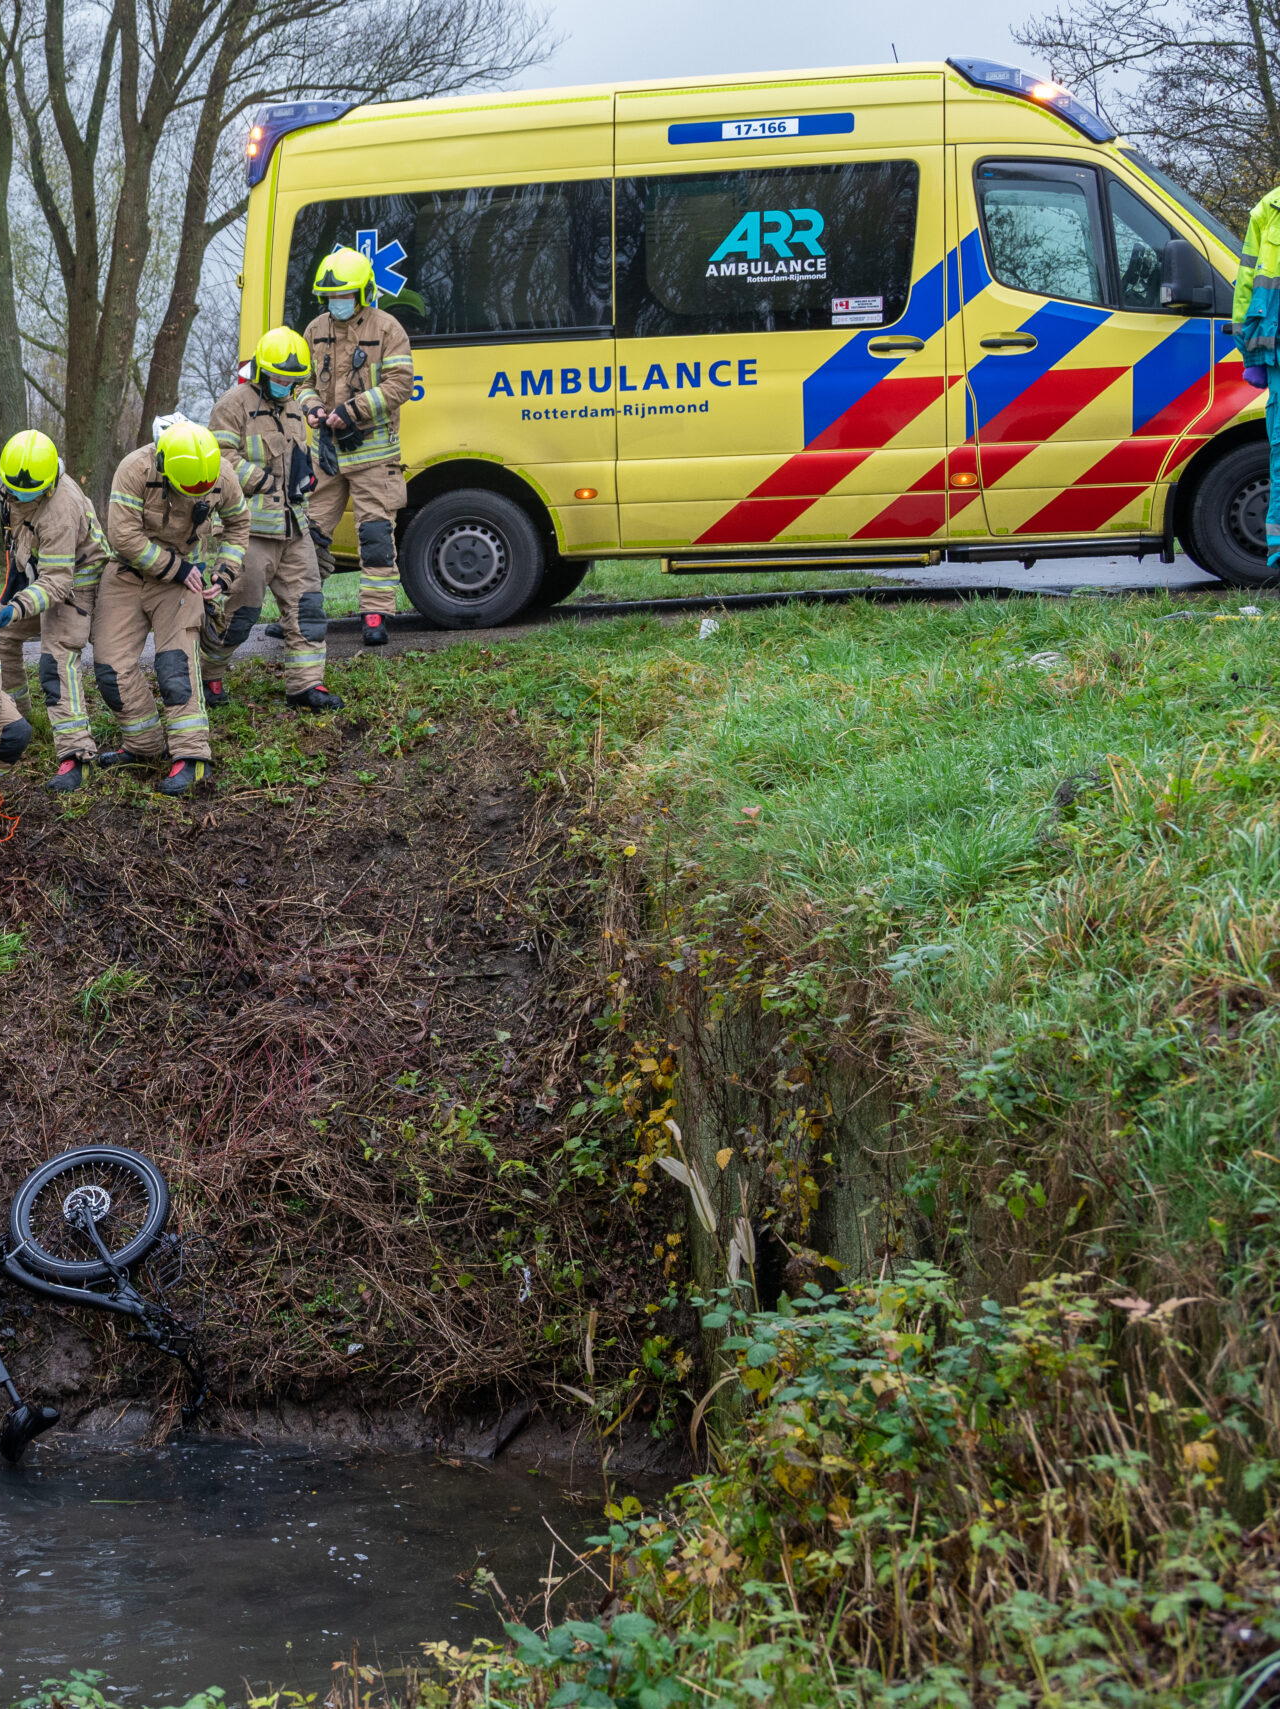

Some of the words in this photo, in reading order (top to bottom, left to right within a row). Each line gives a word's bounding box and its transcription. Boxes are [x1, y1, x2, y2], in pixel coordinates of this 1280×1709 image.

[734, 121, 787, 136] 17-166
[708, 208, 826, 262] ARR
[705, 258, 827, 278] AMBULANCE
[746, 271, 827, 283] Rotterdam-Rijnmond
[487, 358, 758, 398] AMBULANCE
[521, 400, 710, 421] Rotterdam-Rijnmond
